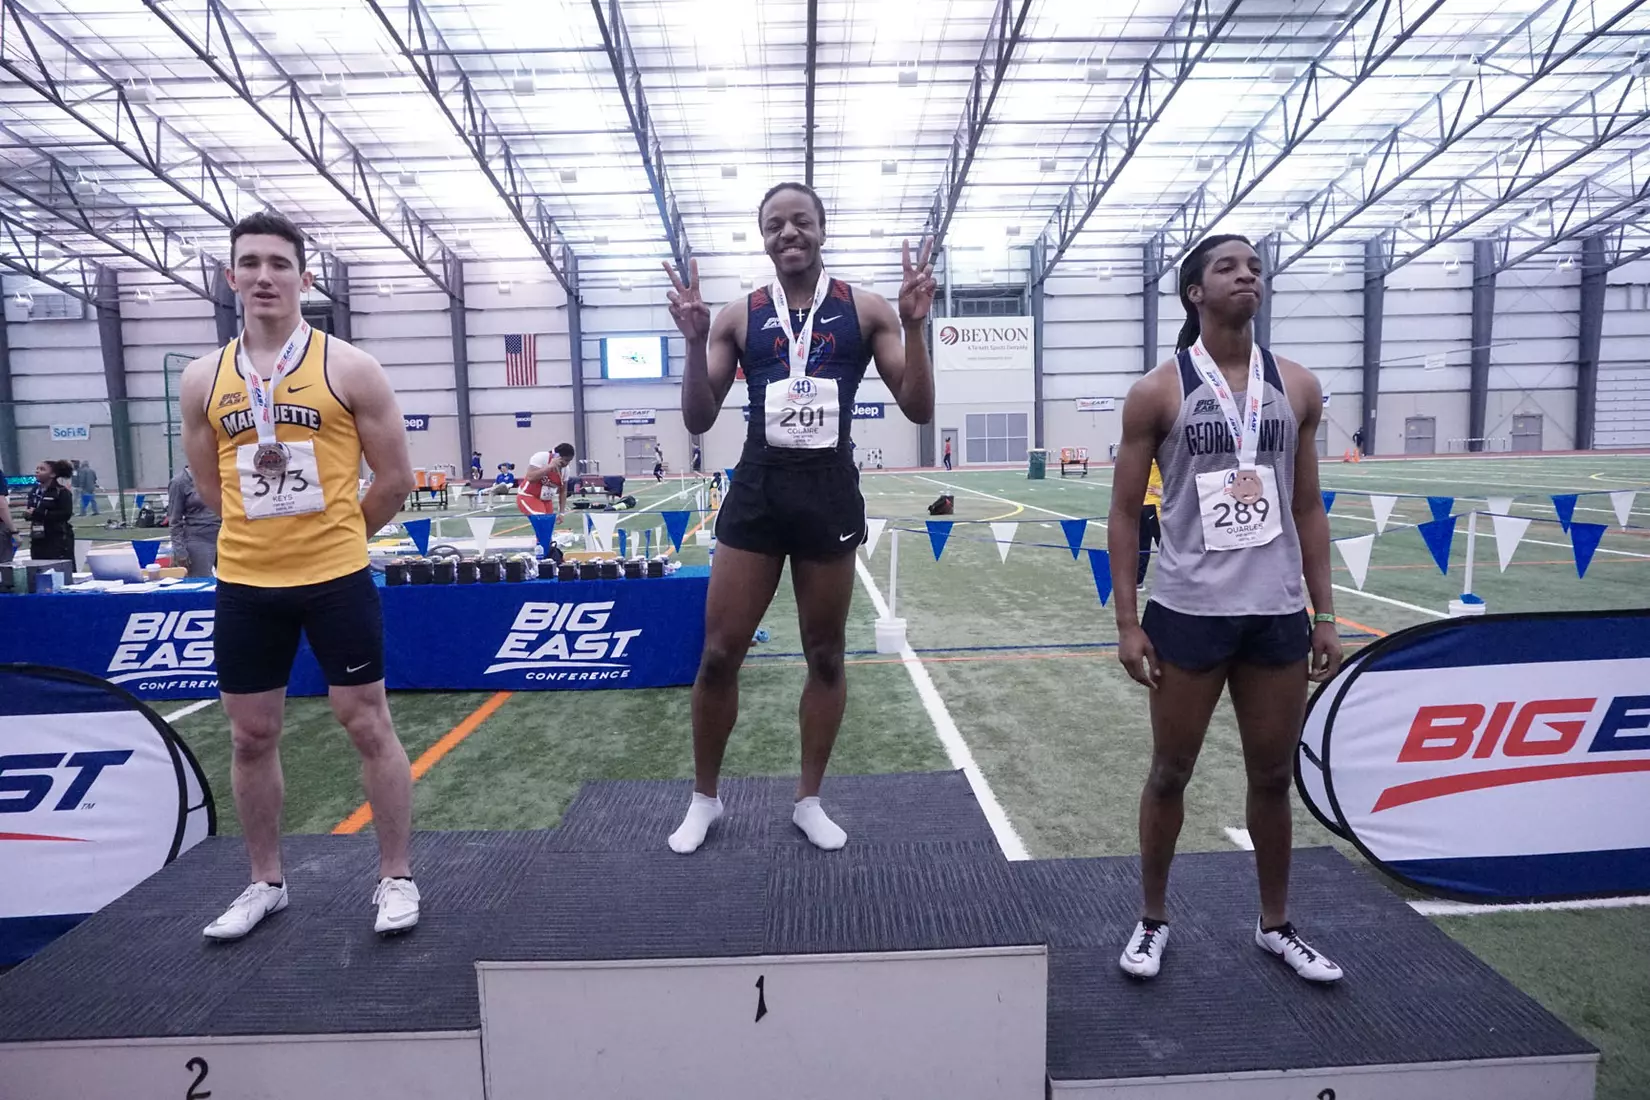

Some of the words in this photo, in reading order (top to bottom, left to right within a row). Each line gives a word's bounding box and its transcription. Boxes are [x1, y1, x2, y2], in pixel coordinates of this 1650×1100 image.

[961, 328, 1028, 342] BEYNON
[793, 380, 811, 393] 40
[222, 405, 320, 437] MARUETTE
[780, 406, 824, 427] 201
[851, 404, 879, 417] Jeep
[53, 427, 76, 437] SoFi
[404, 419, 424, 429] eep
[1185, 418, 1285, 456] GEORGWN
[252, 469, 309, 497] 373
[272, 493, 293, 502] KEYS
[1213, 498, 1269, 528] 289
[1226, 523, 1264, 535] QUARLES
[120, 609, 216, 642] BIG
[511, 601, 615, 632] BIG
[107, 641, 215, 672] EAS
[495, 629, 642, 660] EAST
[139, 680, 218, 690] CONFEREN
[525, 669, 631, 681] CONFERENCE
[755, 974, 768, 1024] 1
[185, 1056, 211, 1100] 2
